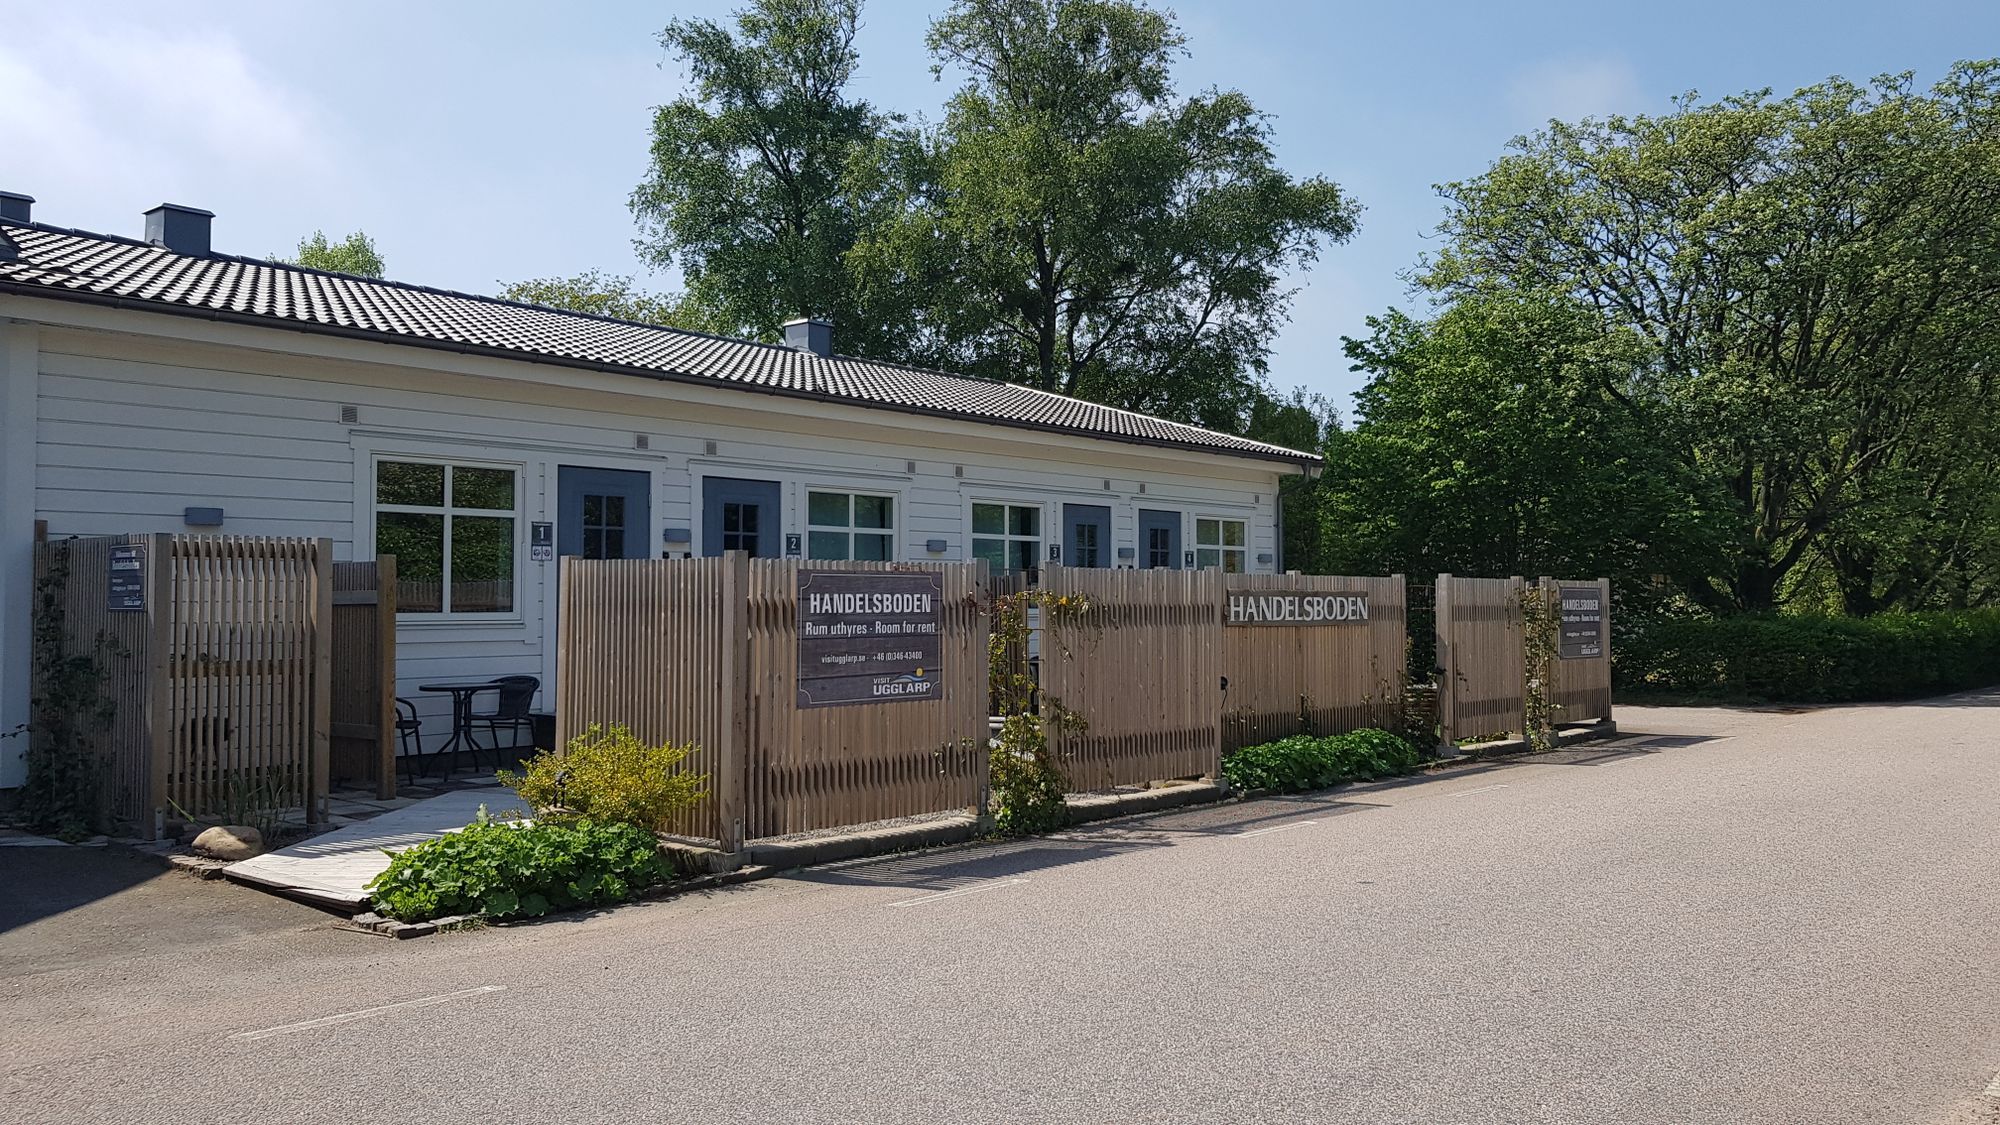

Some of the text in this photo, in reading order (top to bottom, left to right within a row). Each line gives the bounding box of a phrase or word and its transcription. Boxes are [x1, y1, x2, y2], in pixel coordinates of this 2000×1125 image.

[539, 526, 545, 540] 1
[791, 537, 797, 549] 2
[809, 593, 932, 614] HANDELSBODEN
[1229, 595, 1369, 622] HANDELSBODEN
[805, 621, 828, 636] Rum
[830, 621, 867, 638] uthyres
[875, 620, 900, 634] Room
[902, 620, 916, 633] for
[917, 621, 936, 633] rent
[821, 653, 866, 665] visitugglarp.se
[873, 682, 931, 695] UGGLARP
